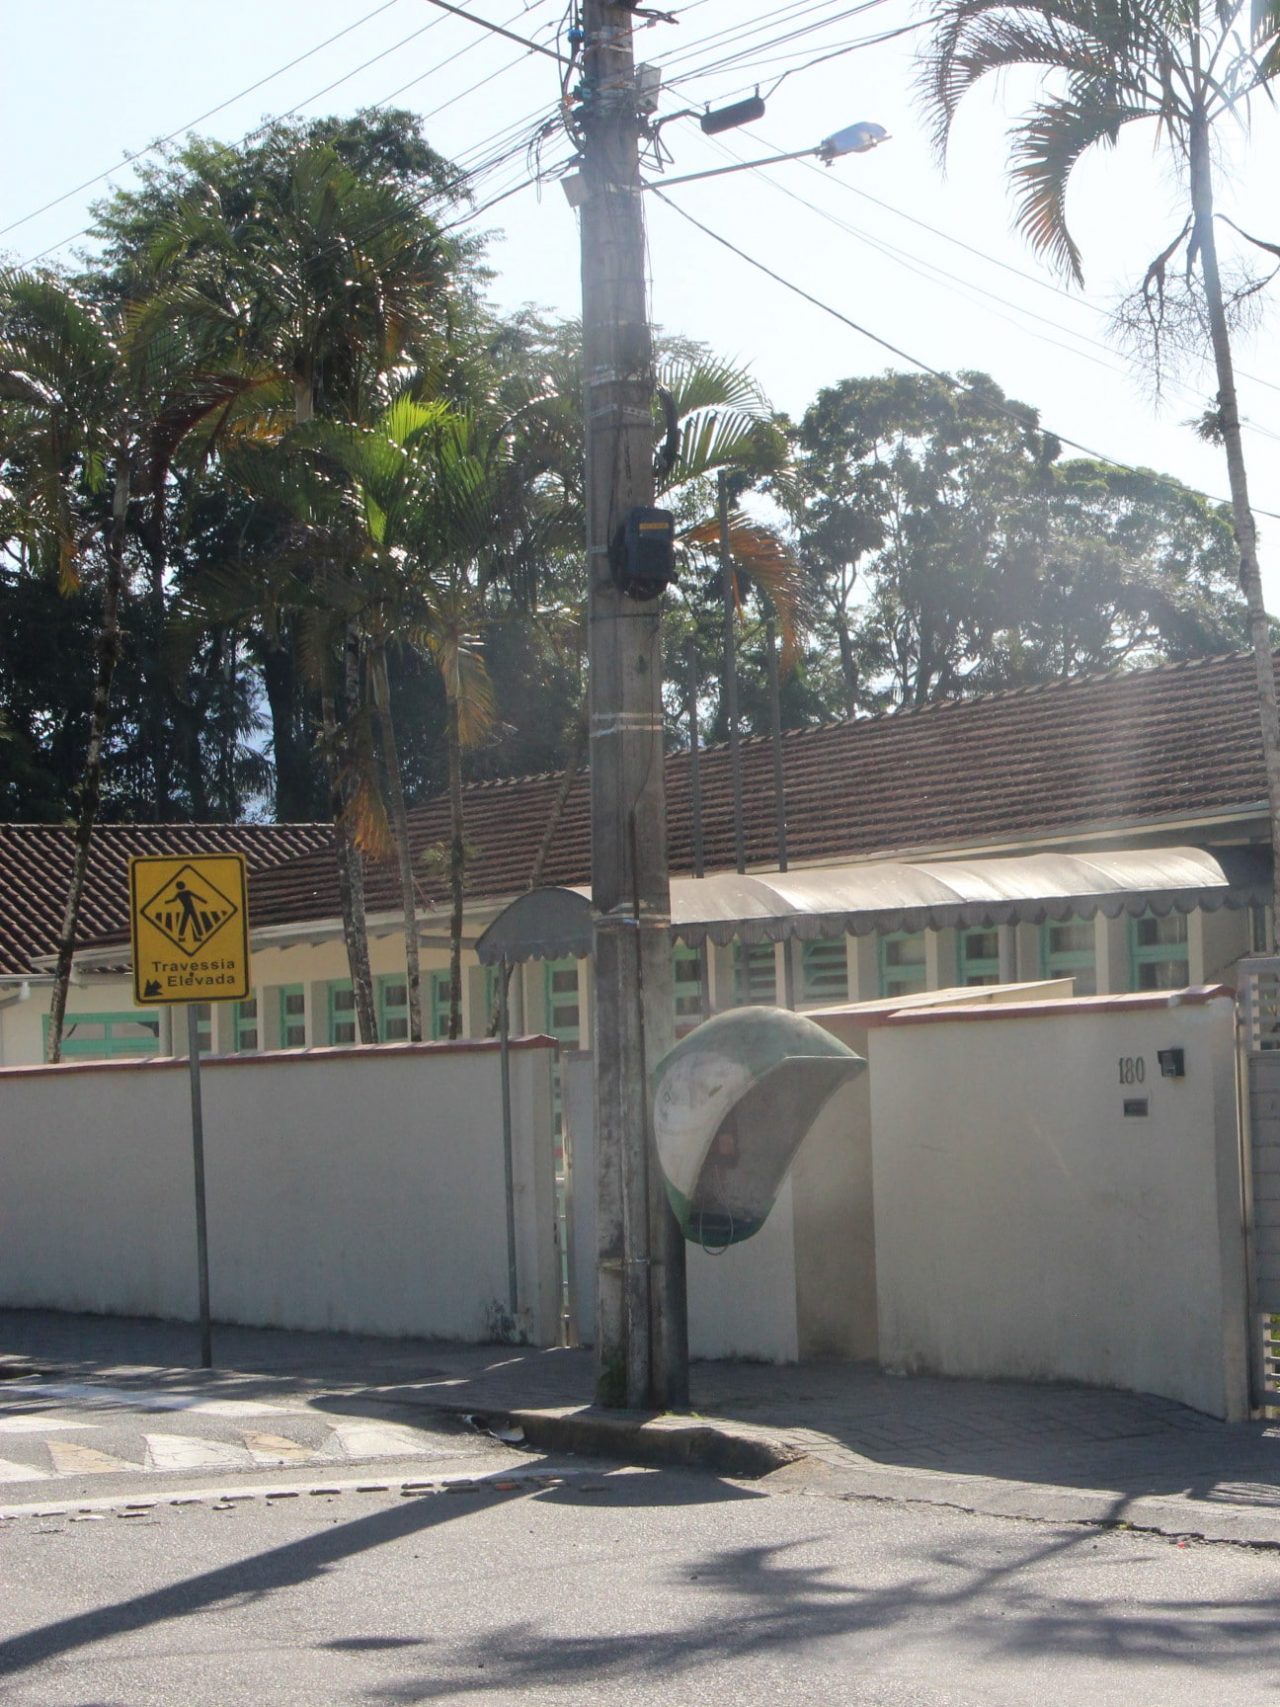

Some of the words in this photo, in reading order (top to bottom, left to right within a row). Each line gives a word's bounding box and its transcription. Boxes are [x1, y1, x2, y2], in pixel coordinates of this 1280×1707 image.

[152, 958, 235, 972] Travessia
[167, 973, 235, 987] Elevada
[1119, 1056, 1145, 1085] 180
